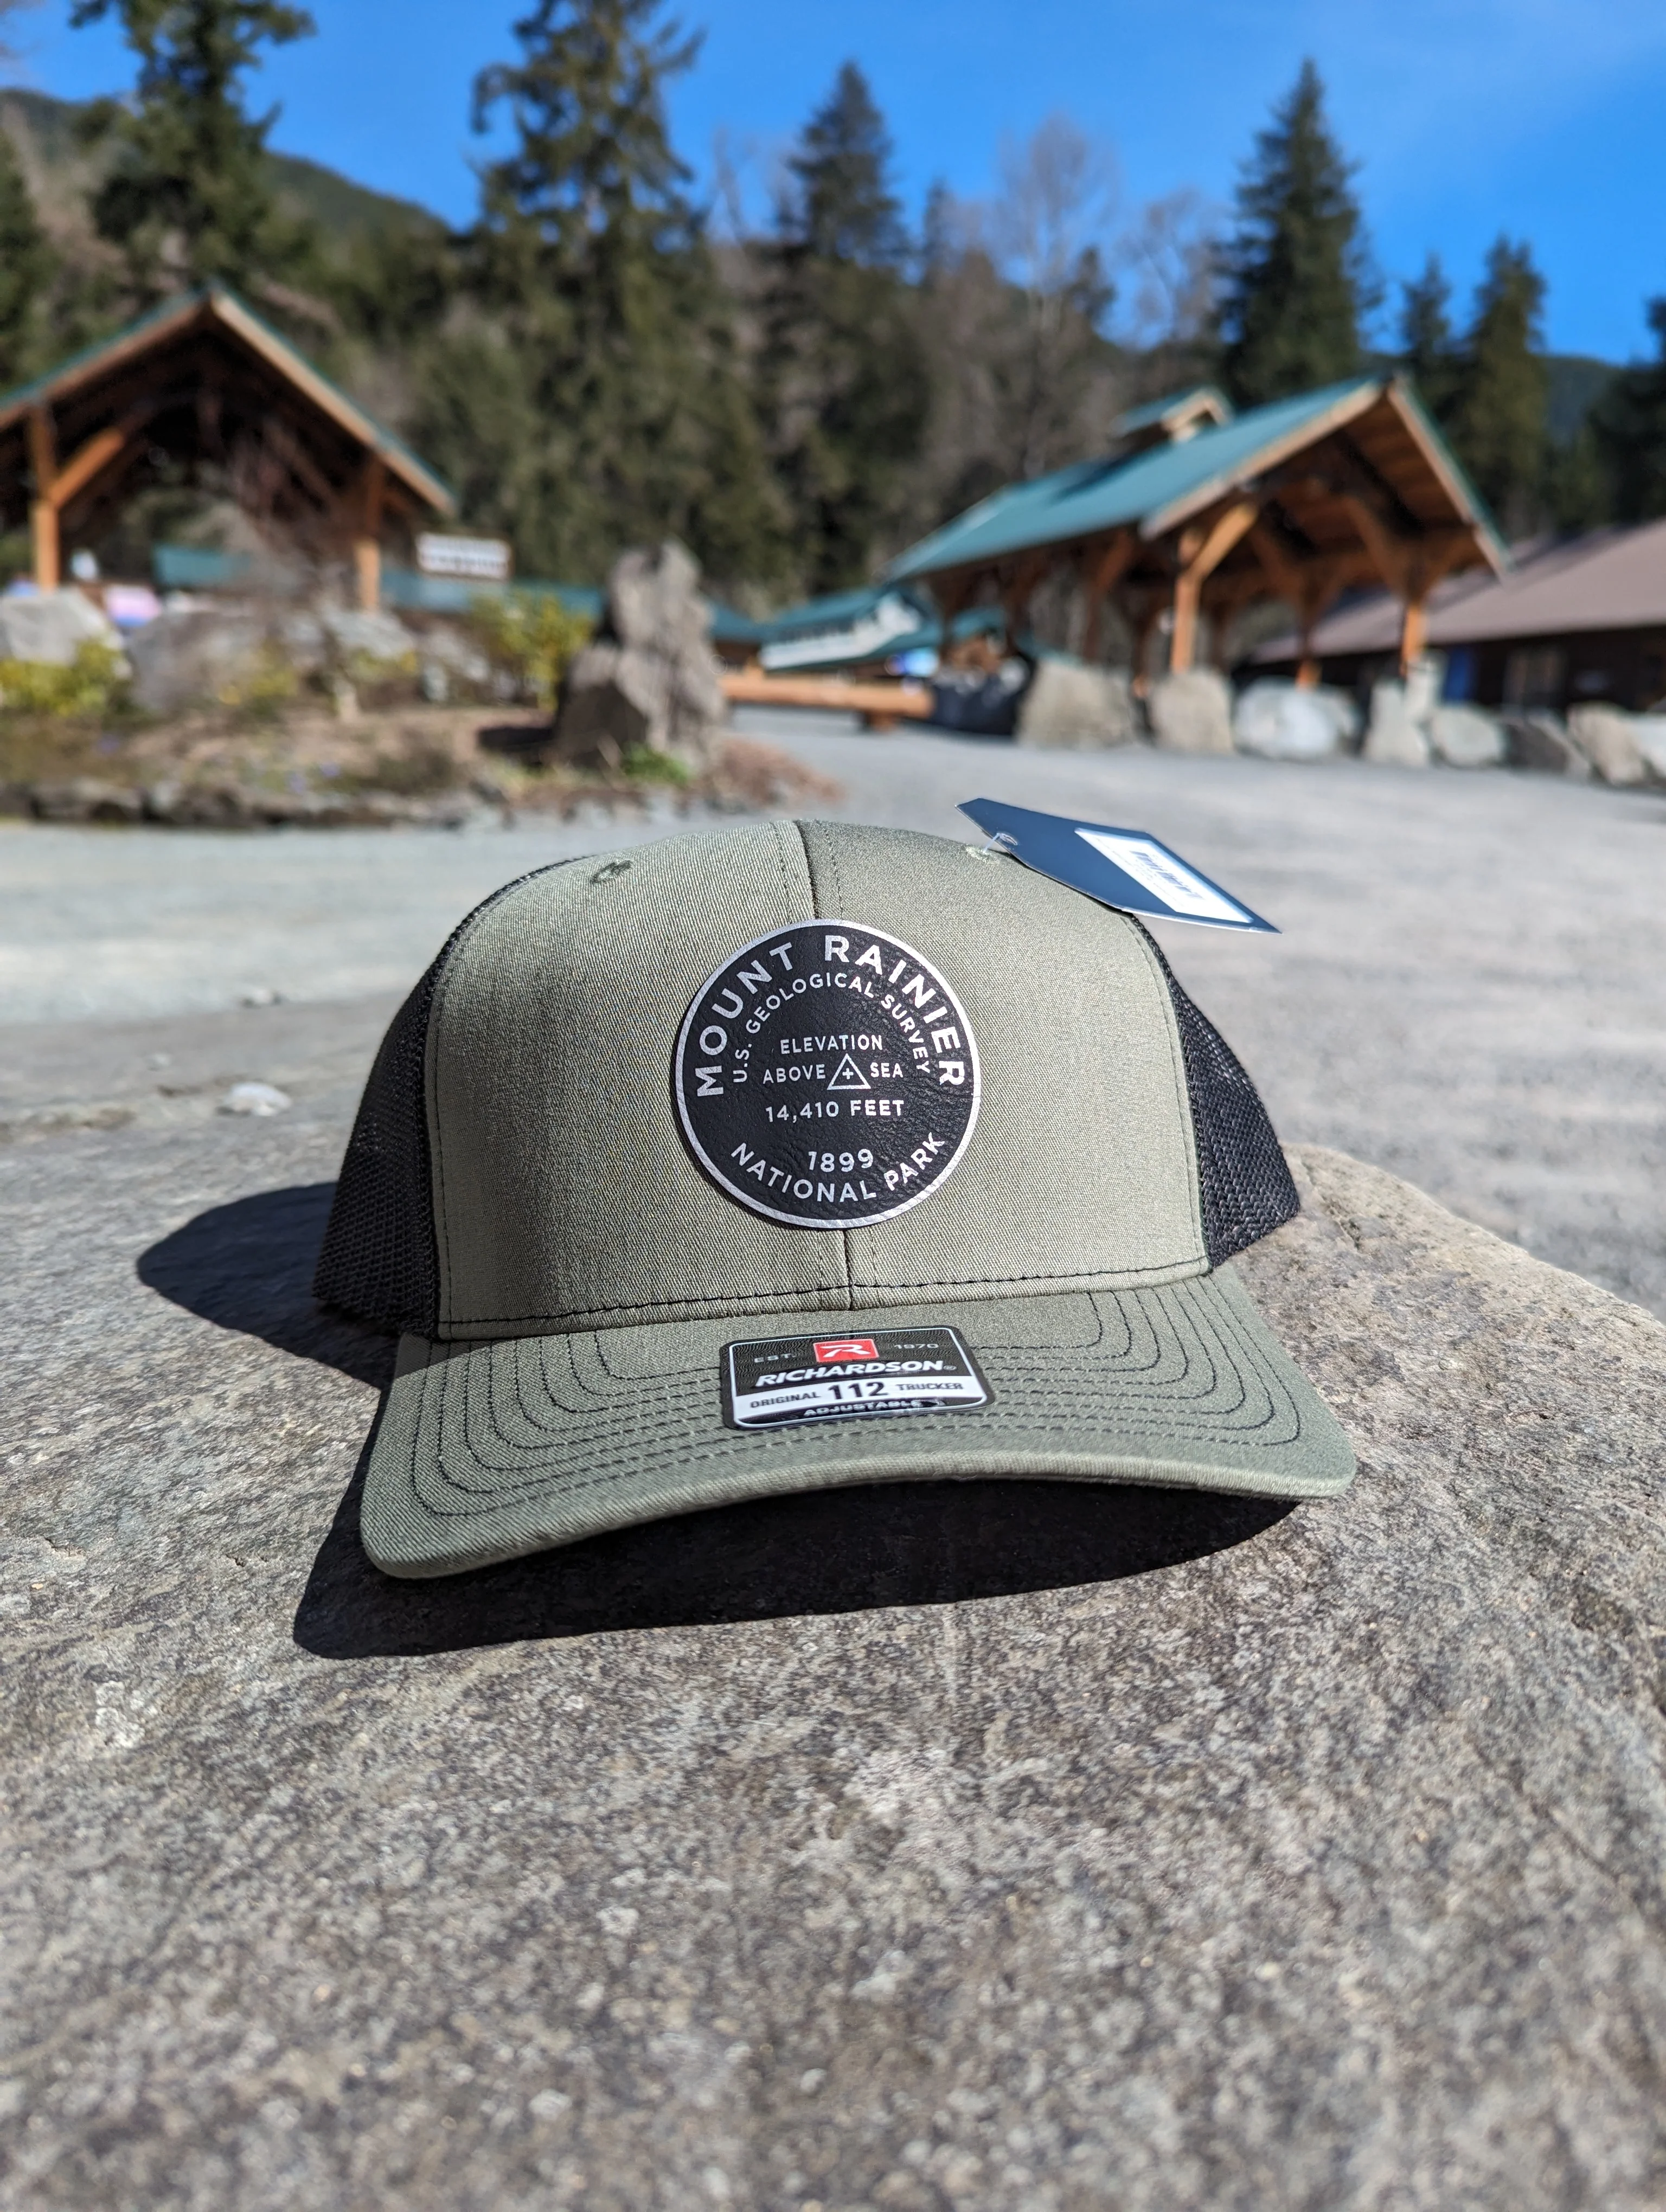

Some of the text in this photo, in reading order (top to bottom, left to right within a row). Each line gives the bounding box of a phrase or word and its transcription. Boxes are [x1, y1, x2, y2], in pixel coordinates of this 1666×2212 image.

[695, 935, 965, 1097] MOUNT RAINIER
[733, 972, 931, 1083] U.S. GEOLOGICAL SURVEY
[780, 1034, 883, 1054] ELEVATION
[763, 1063, 903, 1084] ABOVE SEA
[765, 1099, 904, 1123] 14,410 FEET
[731, 1131, 945, 1203] NATIONAL PARK
[808, 1148, 873, 1172] 1899
[750, 1391, 821, 1408] ORIGINAL
[828, 1381, 889, 1400] 112
[803, 1400, 922, 1417] ADJUSTABLE
